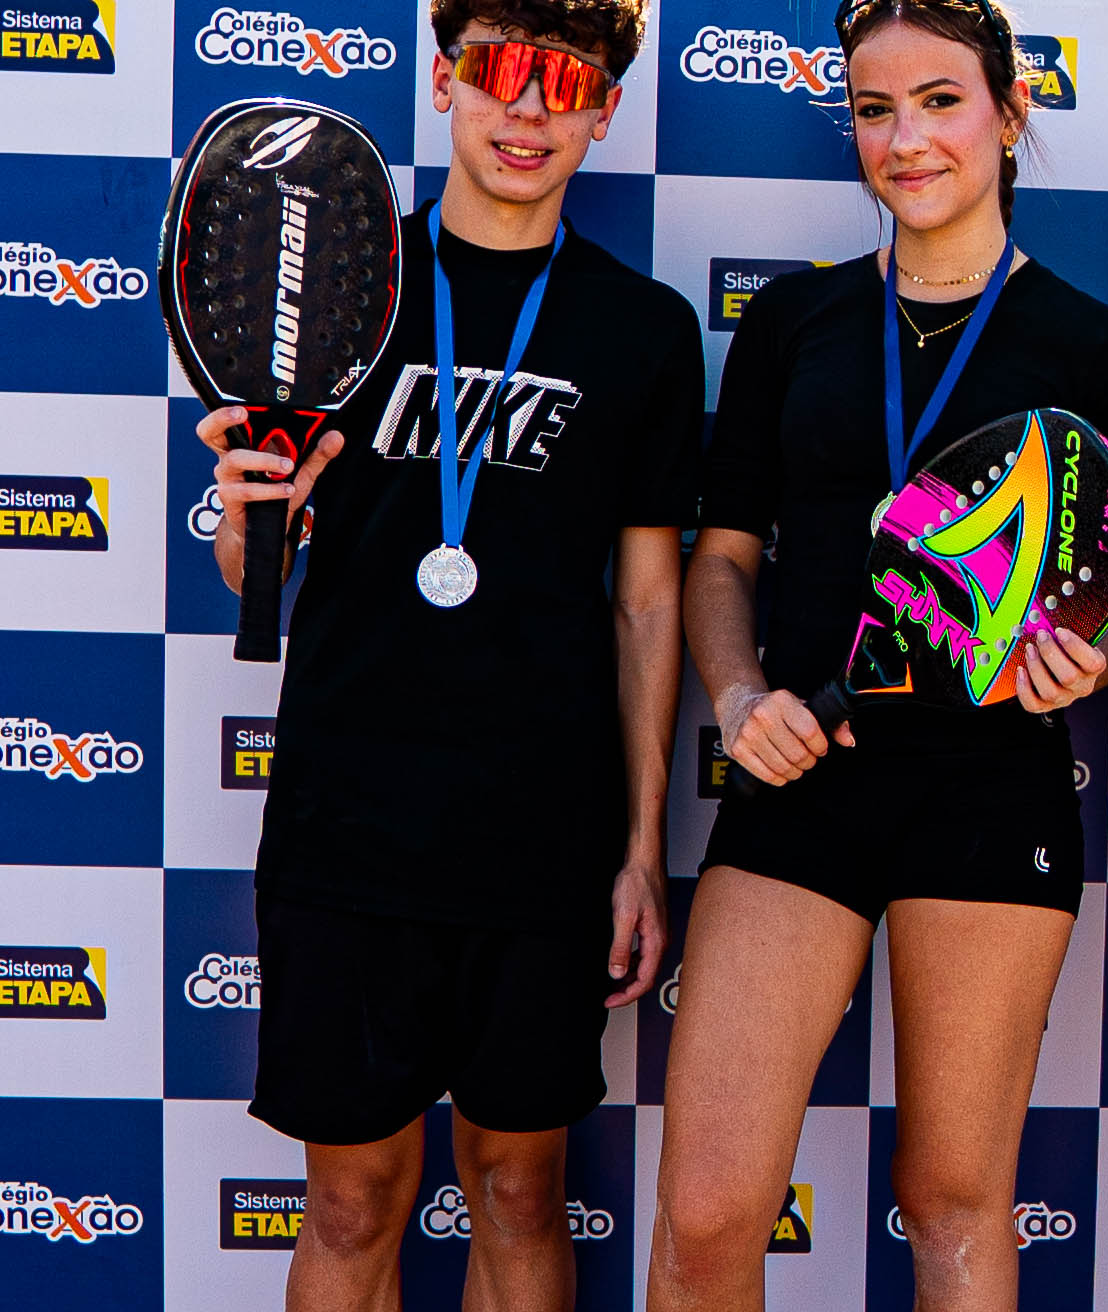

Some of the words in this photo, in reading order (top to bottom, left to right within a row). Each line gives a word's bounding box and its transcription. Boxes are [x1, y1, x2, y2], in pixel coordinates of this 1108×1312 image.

[2, 10, 82, 30] Sistema
[215, 8, 300, 37] Colégio
[1, 31, 100, 60] ETAPA
[699, 29, 783, 54] Colégio
[271, 196, 308, 384] mormaii
[723, 272, 775, 289] Siste
[331, 359, 367, 396] TRIAX
[372, 364, 583, 472] NIKE
[0, 488, 76, 508] Sistema
[1058, 430, 1081, 574] CYCLONE
[0, 510, 94, 537] ETAPA
[872, 568, 986, 676] SHARK
[892, 630, 909, 653] PRO
[0, 959, 73, 978] Sistema
[0, 981, 92, 1006] ETAPA
